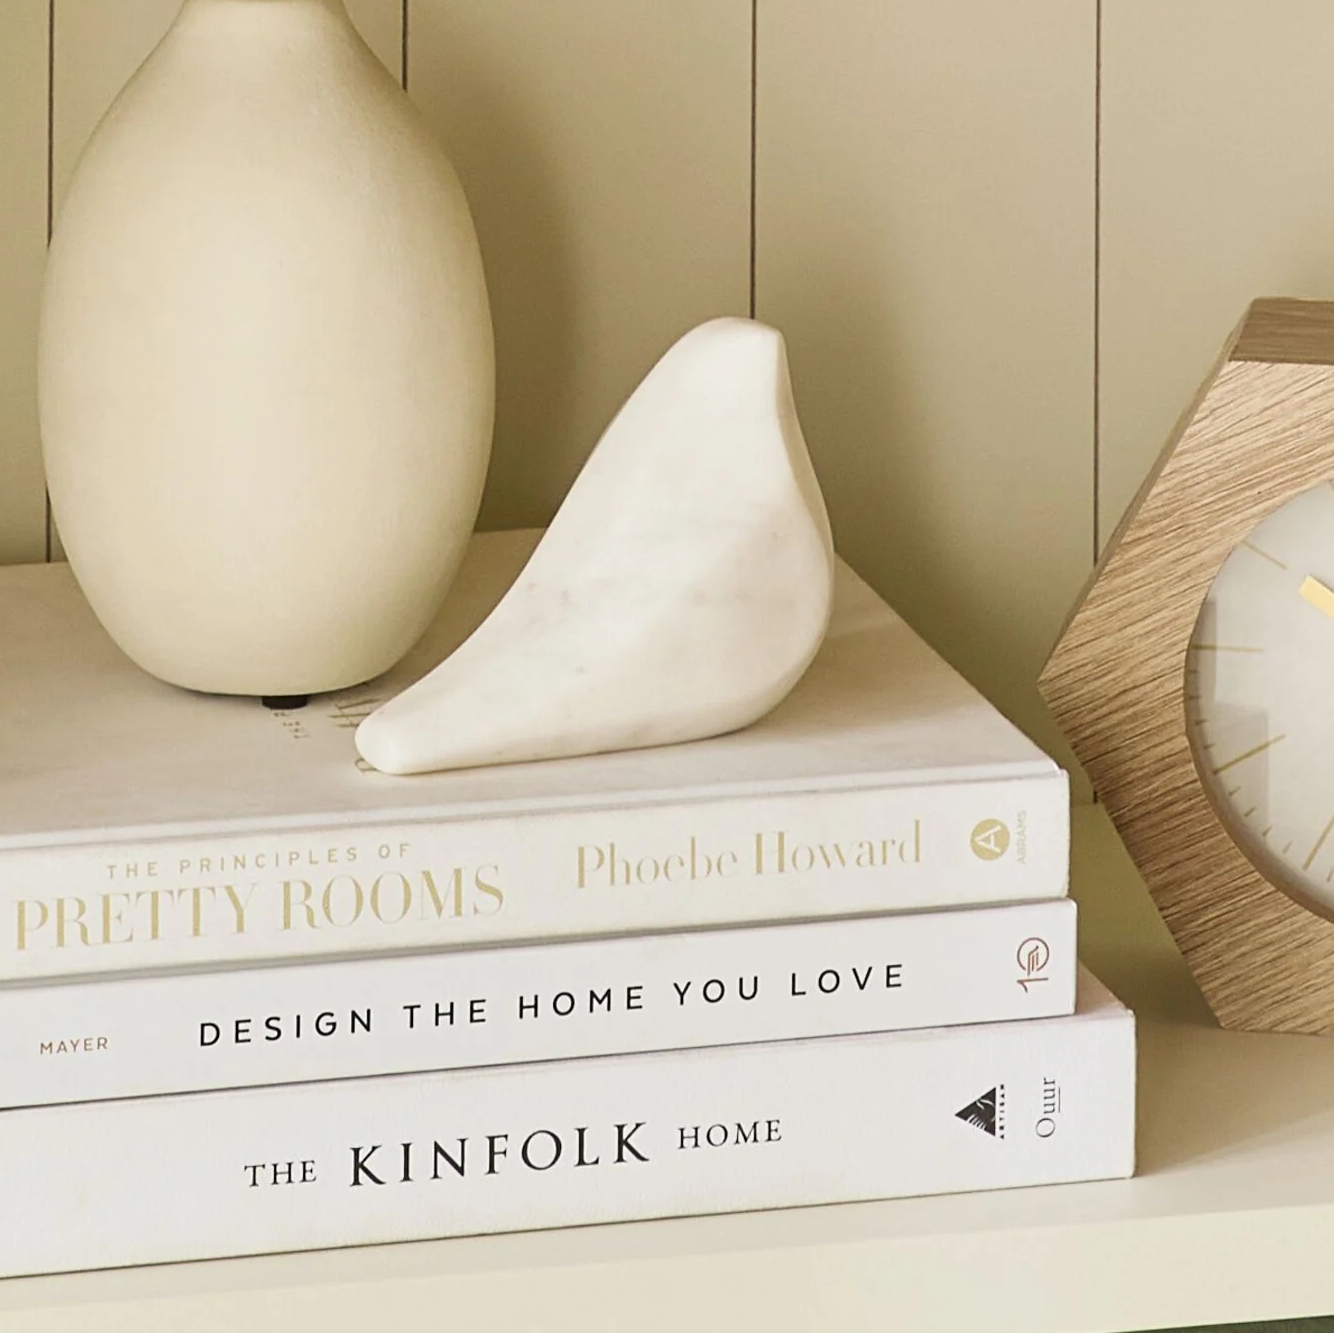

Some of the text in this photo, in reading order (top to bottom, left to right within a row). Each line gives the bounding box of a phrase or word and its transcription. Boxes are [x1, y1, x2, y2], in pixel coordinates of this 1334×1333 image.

[106, 841, 413, 881] THE PRINCIPLES OF
[577, 819, 920, 889] Phoebe Howard
[1015, 809, 1029, 866] ABRAMS
[14, 864, 506, 952] PRETTY ROOMS
[200, 964, 902, 1047] DESIGN THE HOME YOU LOVE
[40, 1037, 108, 1055] MAYER
[1035, 1076, 1056, 1139] Ouur
[244, 1119, 781, 1187] THE KINFOLK HOME
